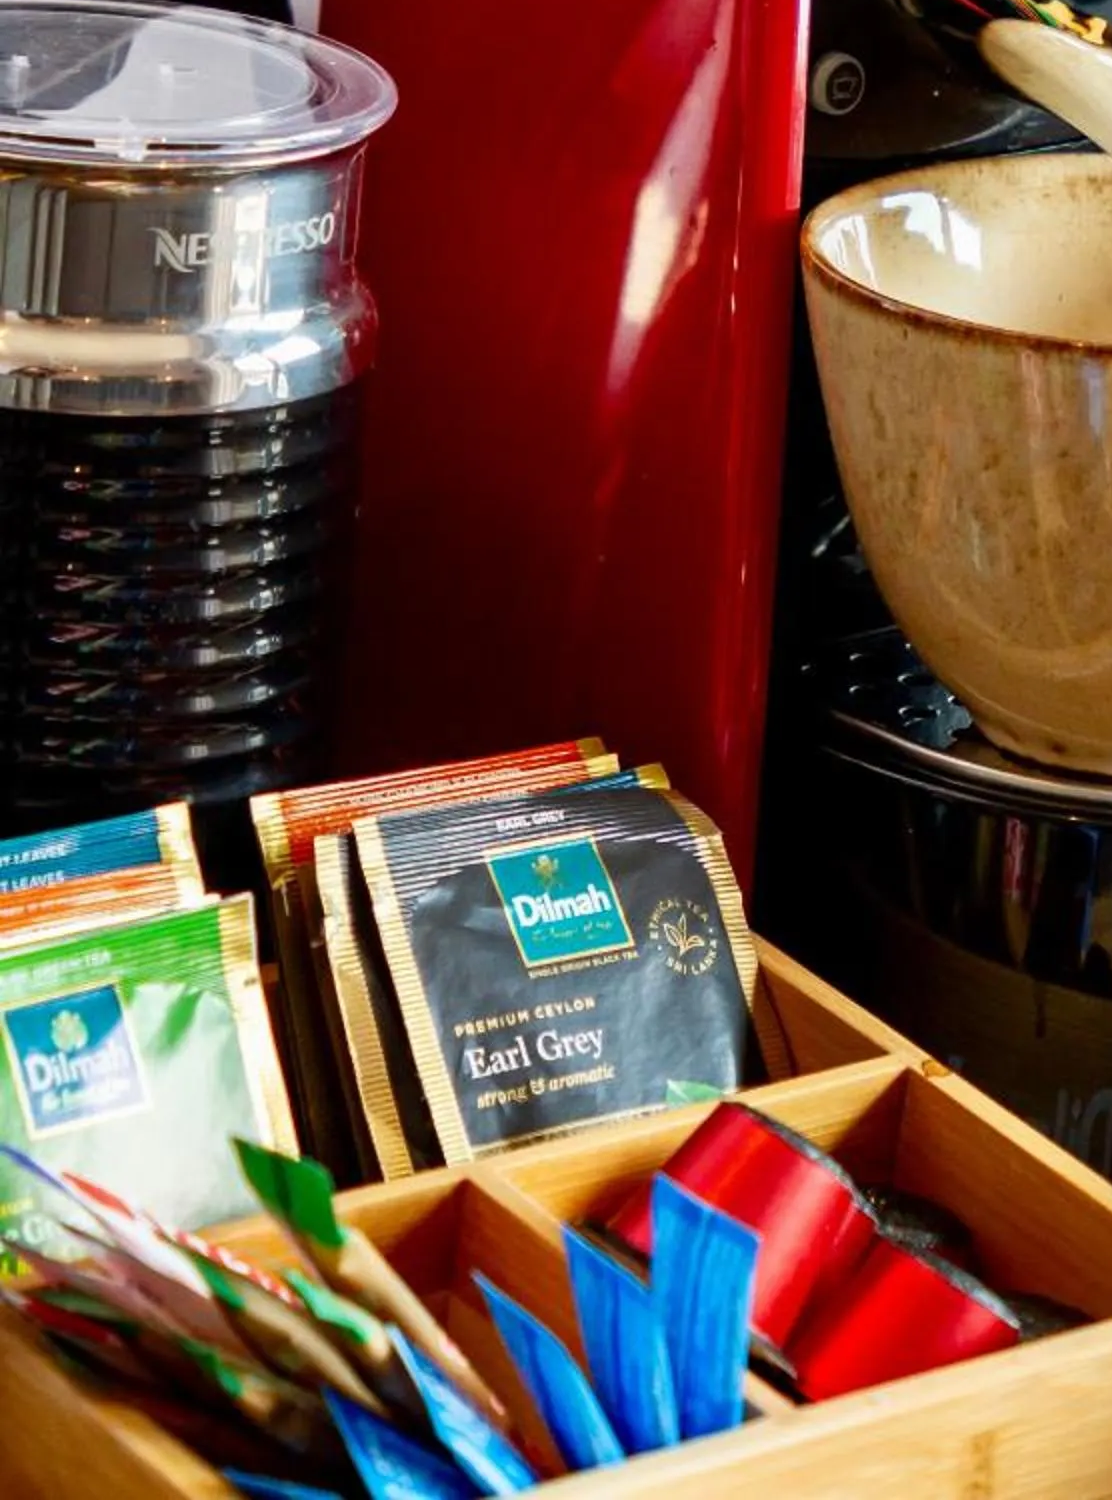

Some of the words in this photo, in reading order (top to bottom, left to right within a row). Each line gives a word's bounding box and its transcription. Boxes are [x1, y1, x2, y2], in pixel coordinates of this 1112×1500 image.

[147, 213, 334, 273] NEESSO
[495, 812, 532, 832] EARL
[533, 807, 566, 825] GREY
[511, 884, 612, 927] Dilmah
[593, 953, 622, 967] BLACK
[623, 949, 640, 961] TEA
[666, 956, 688, 975] SRI
[691, 938, 718, 976] LANKA
[454, 1009, 531, 1039] PREMIUM
[534, 996, 596, 1020] CEYLON
[464, 1036, 532, 1080] Earl
[536, 1028, 604, 1061] Grey
[477, 1084, 529, 1110] strong
[549, 1063, 616, 1091] aromatic
